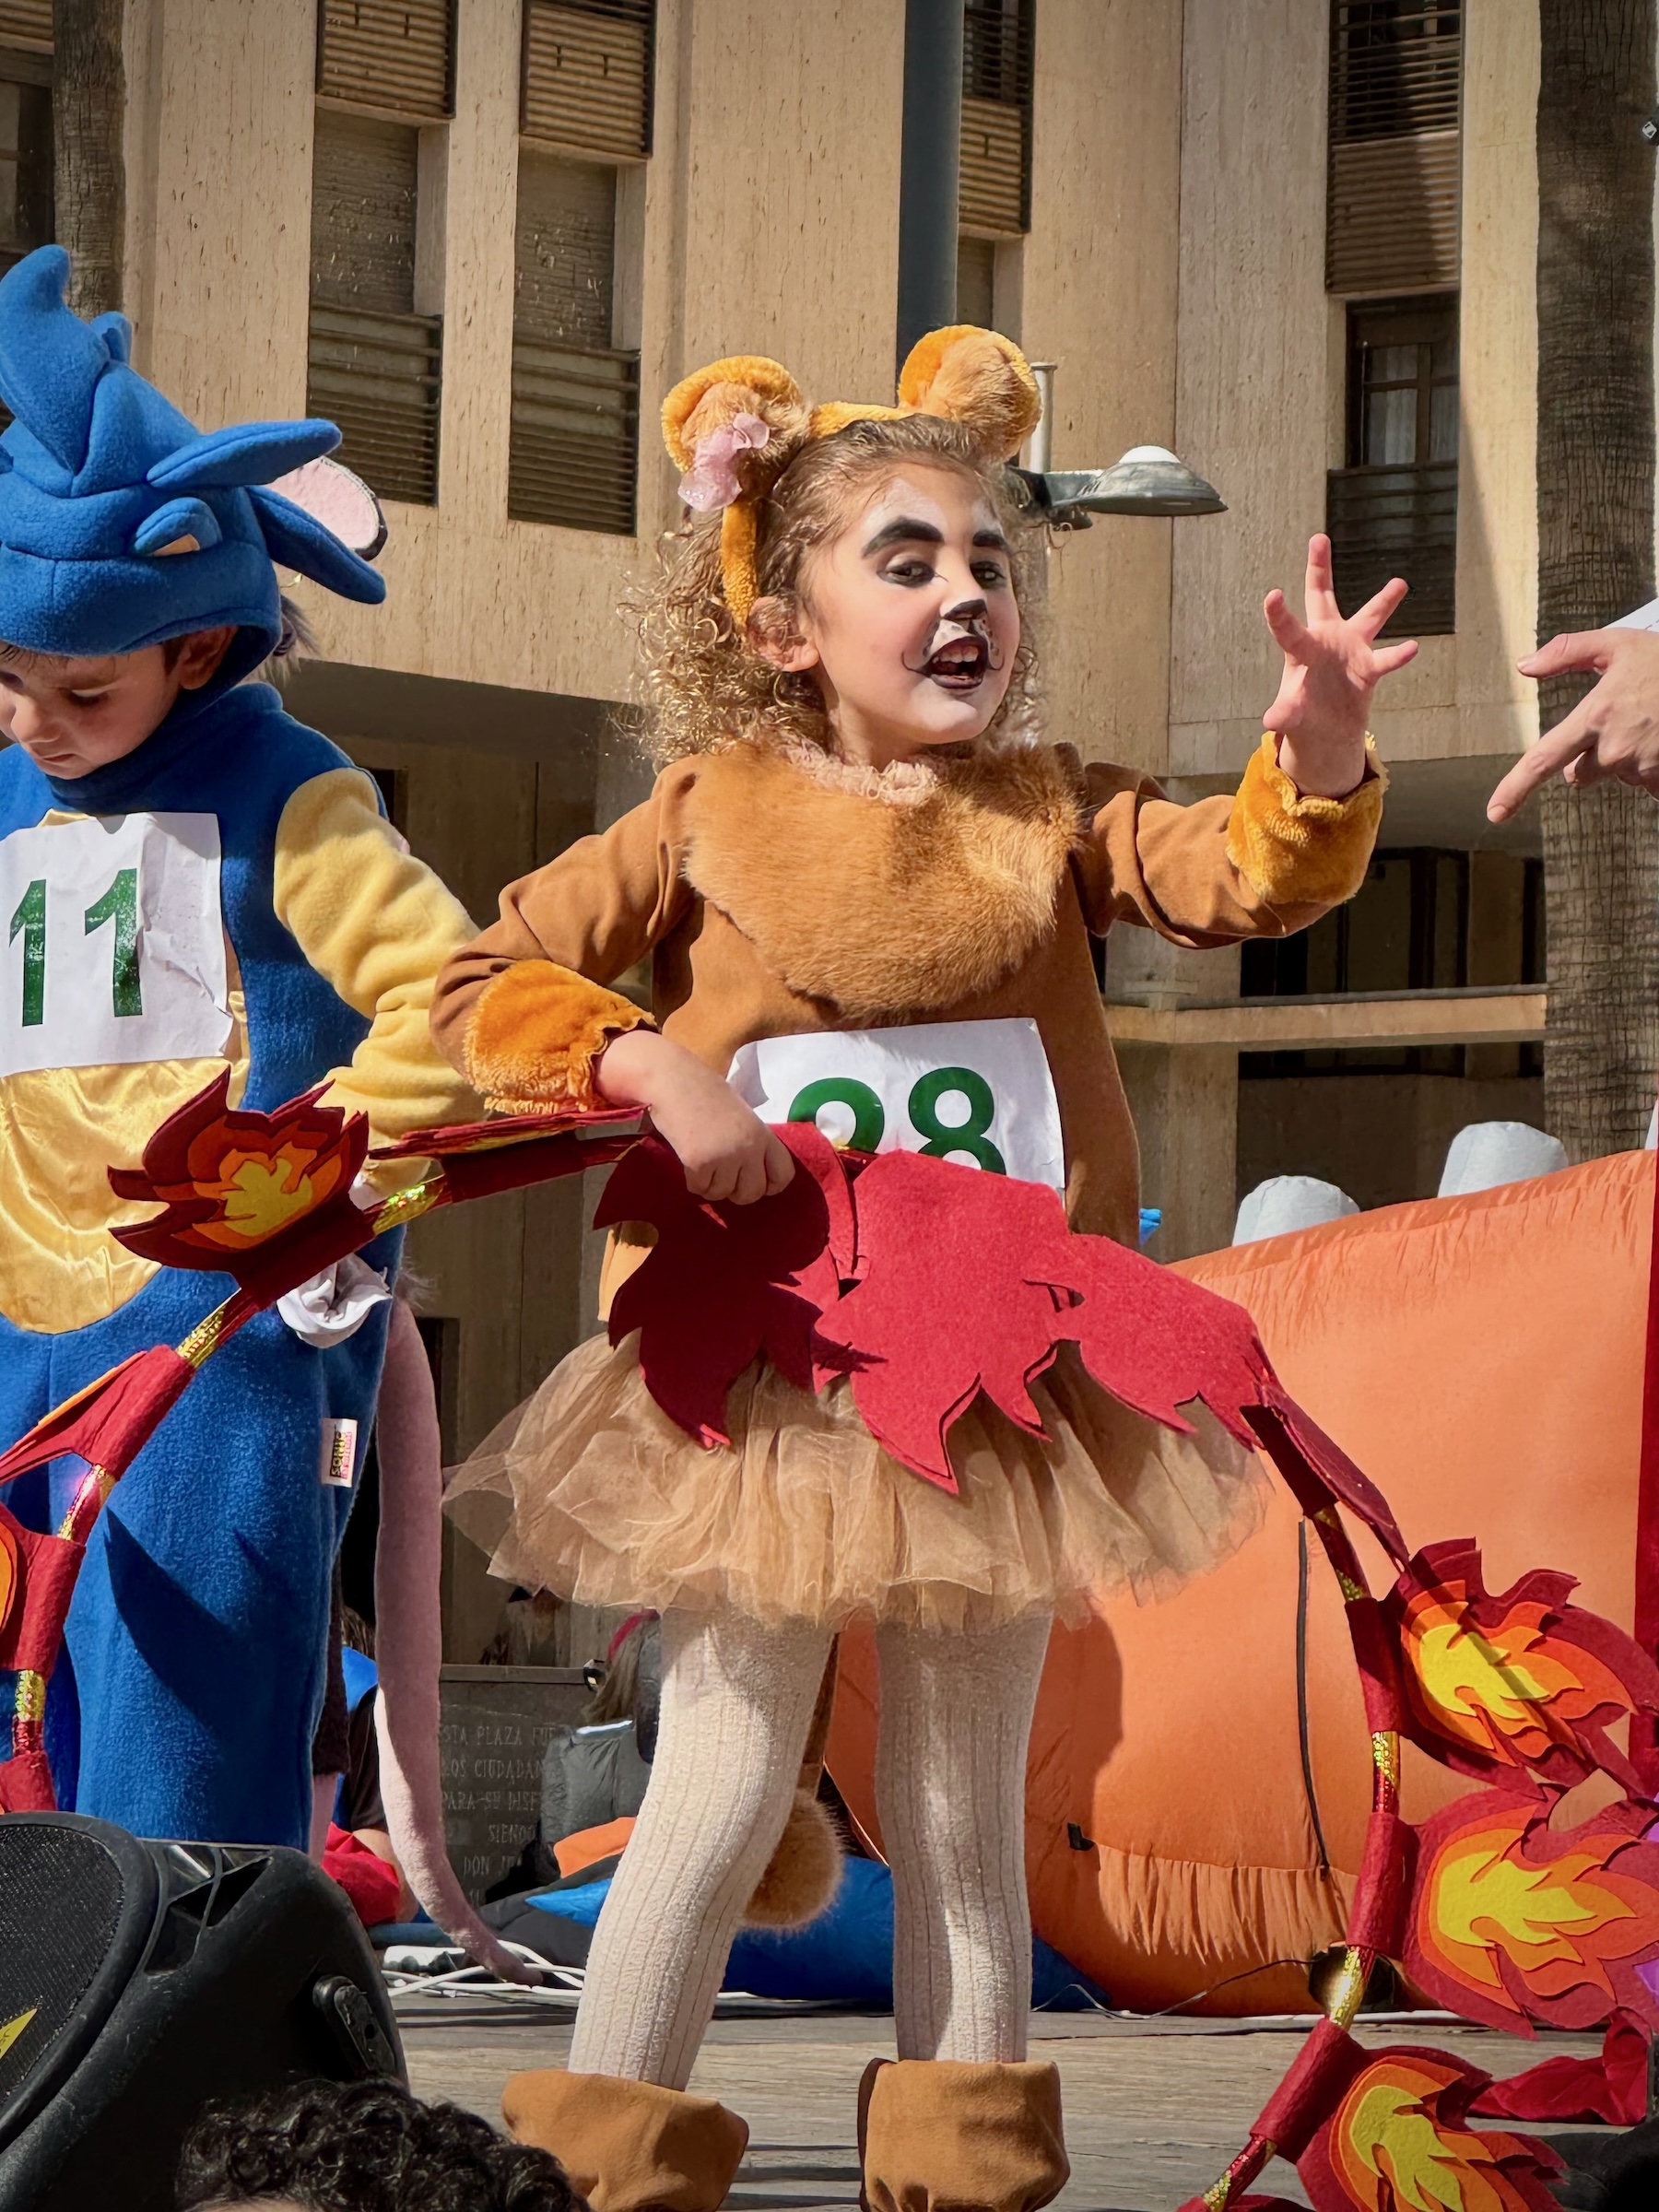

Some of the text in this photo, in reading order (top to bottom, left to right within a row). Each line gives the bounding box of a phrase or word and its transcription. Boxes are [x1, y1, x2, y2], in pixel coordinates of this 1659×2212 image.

[9, 867, 143, 1027] 11
[441, 1724, 468, 1746] STA
[477, 1725, 523, 1746] PLAZA
[474, 1758, 543, 1780] CIUDADAN
[508, 1791, 540, 1811] DISF
[463, 1855, 490, 1877] DON
